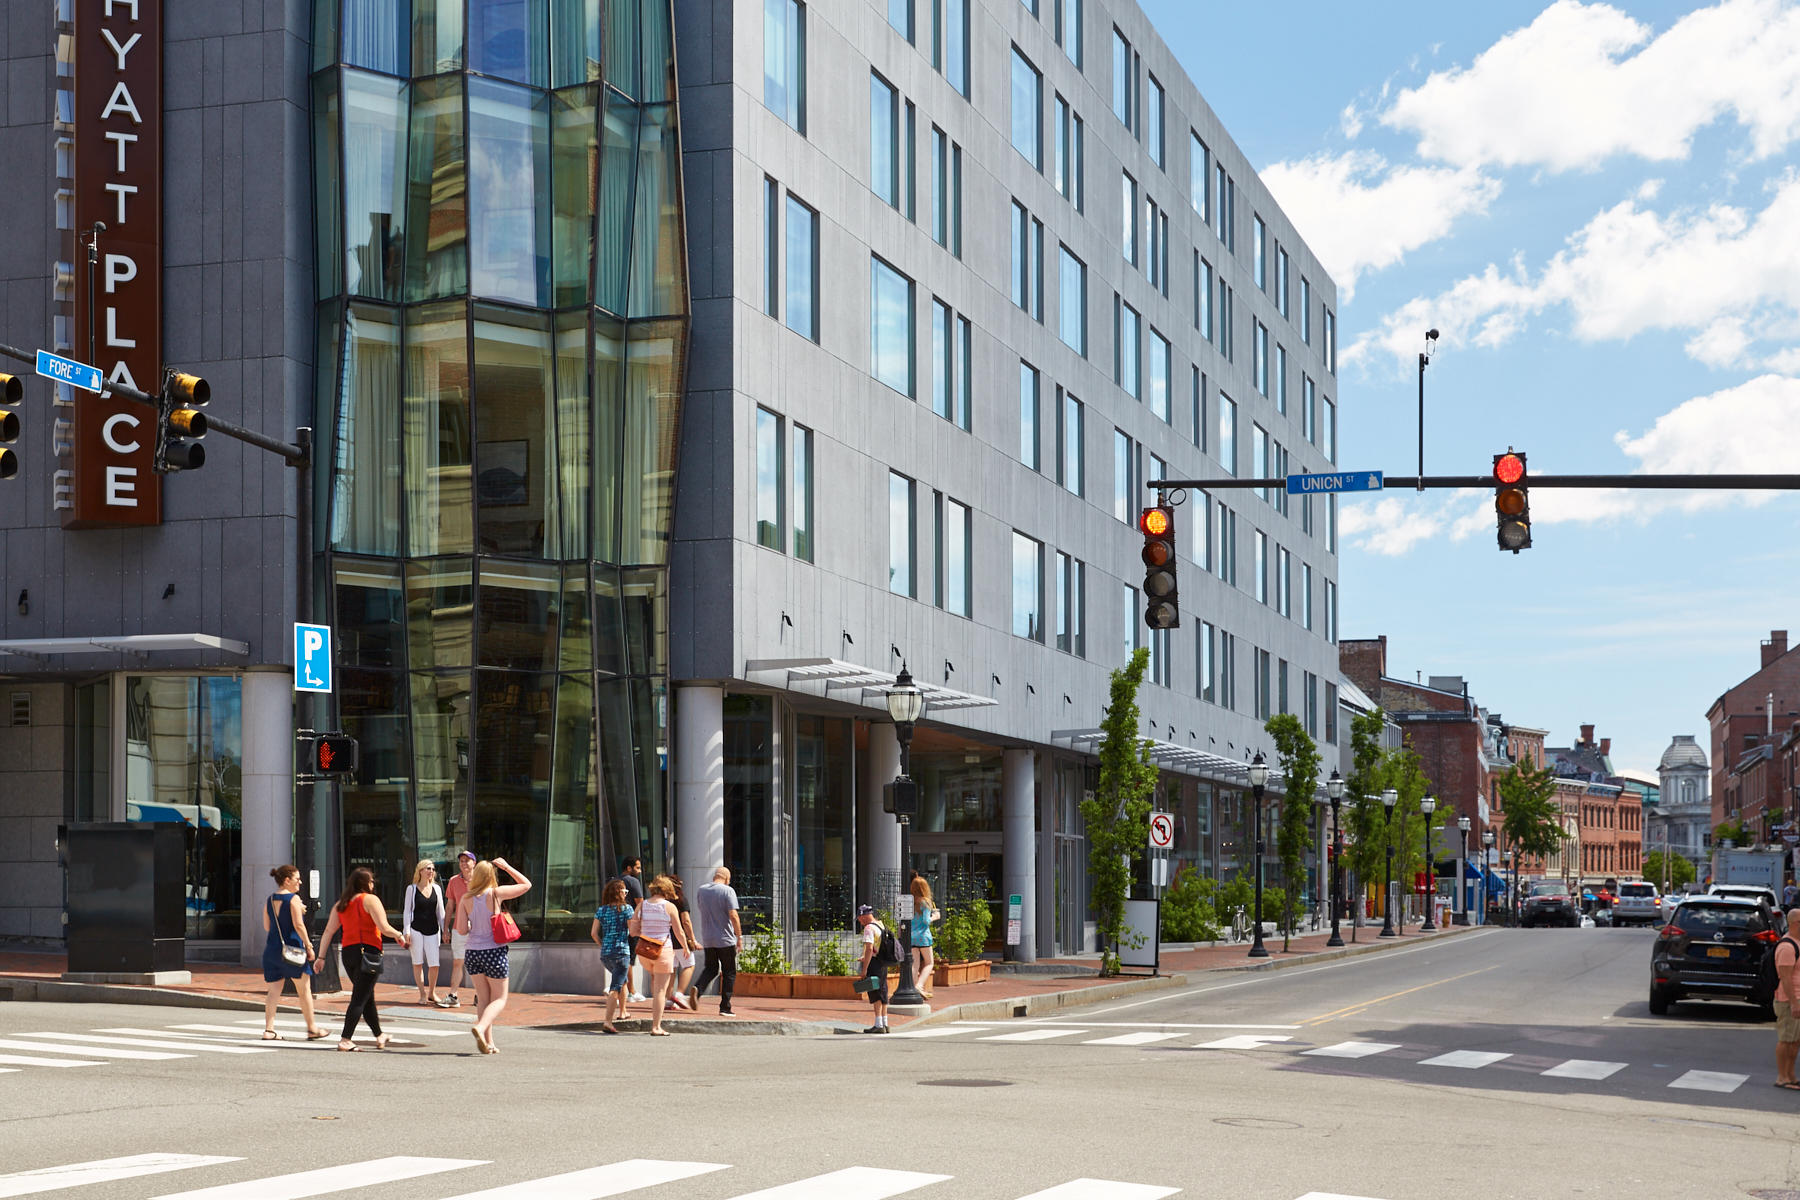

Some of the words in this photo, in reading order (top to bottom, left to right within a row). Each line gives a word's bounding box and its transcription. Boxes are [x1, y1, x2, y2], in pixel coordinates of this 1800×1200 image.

[49, 359, 74, 379] FORE
[76, 367, 82, 375] ST
[101, 253, 141, 507] PLACE
[1302, 476, 1342, 490] UNION
[1346, 475, 1354, 483] ST
[304, 630, 323, 660] P
